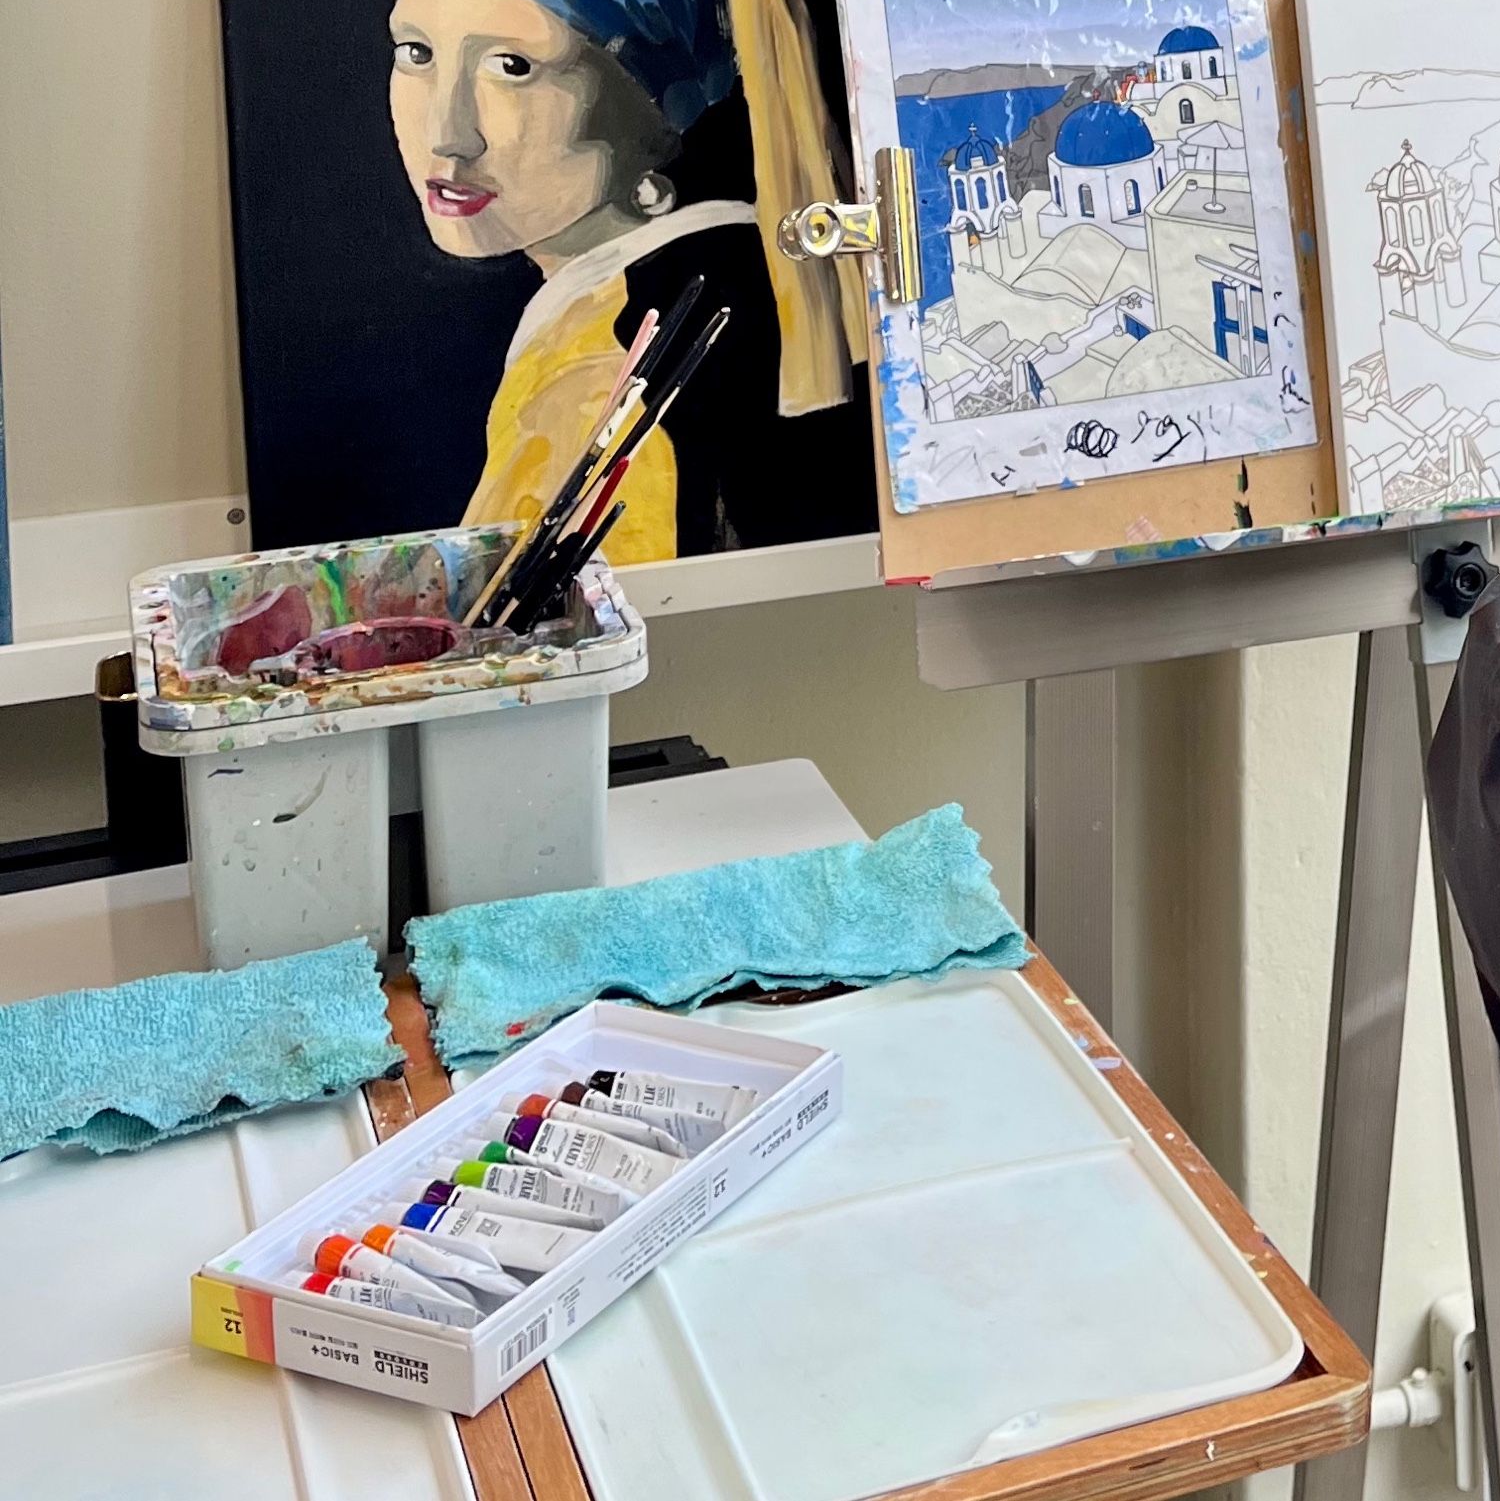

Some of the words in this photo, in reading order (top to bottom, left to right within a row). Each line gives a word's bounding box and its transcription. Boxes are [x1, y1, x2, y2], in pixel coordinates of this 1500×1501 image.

[224, 1317, 242, 1335] 12
[311, 1344, 360, 1366] BASIC+
[374, 1359, 429, 1385] SHIELD
